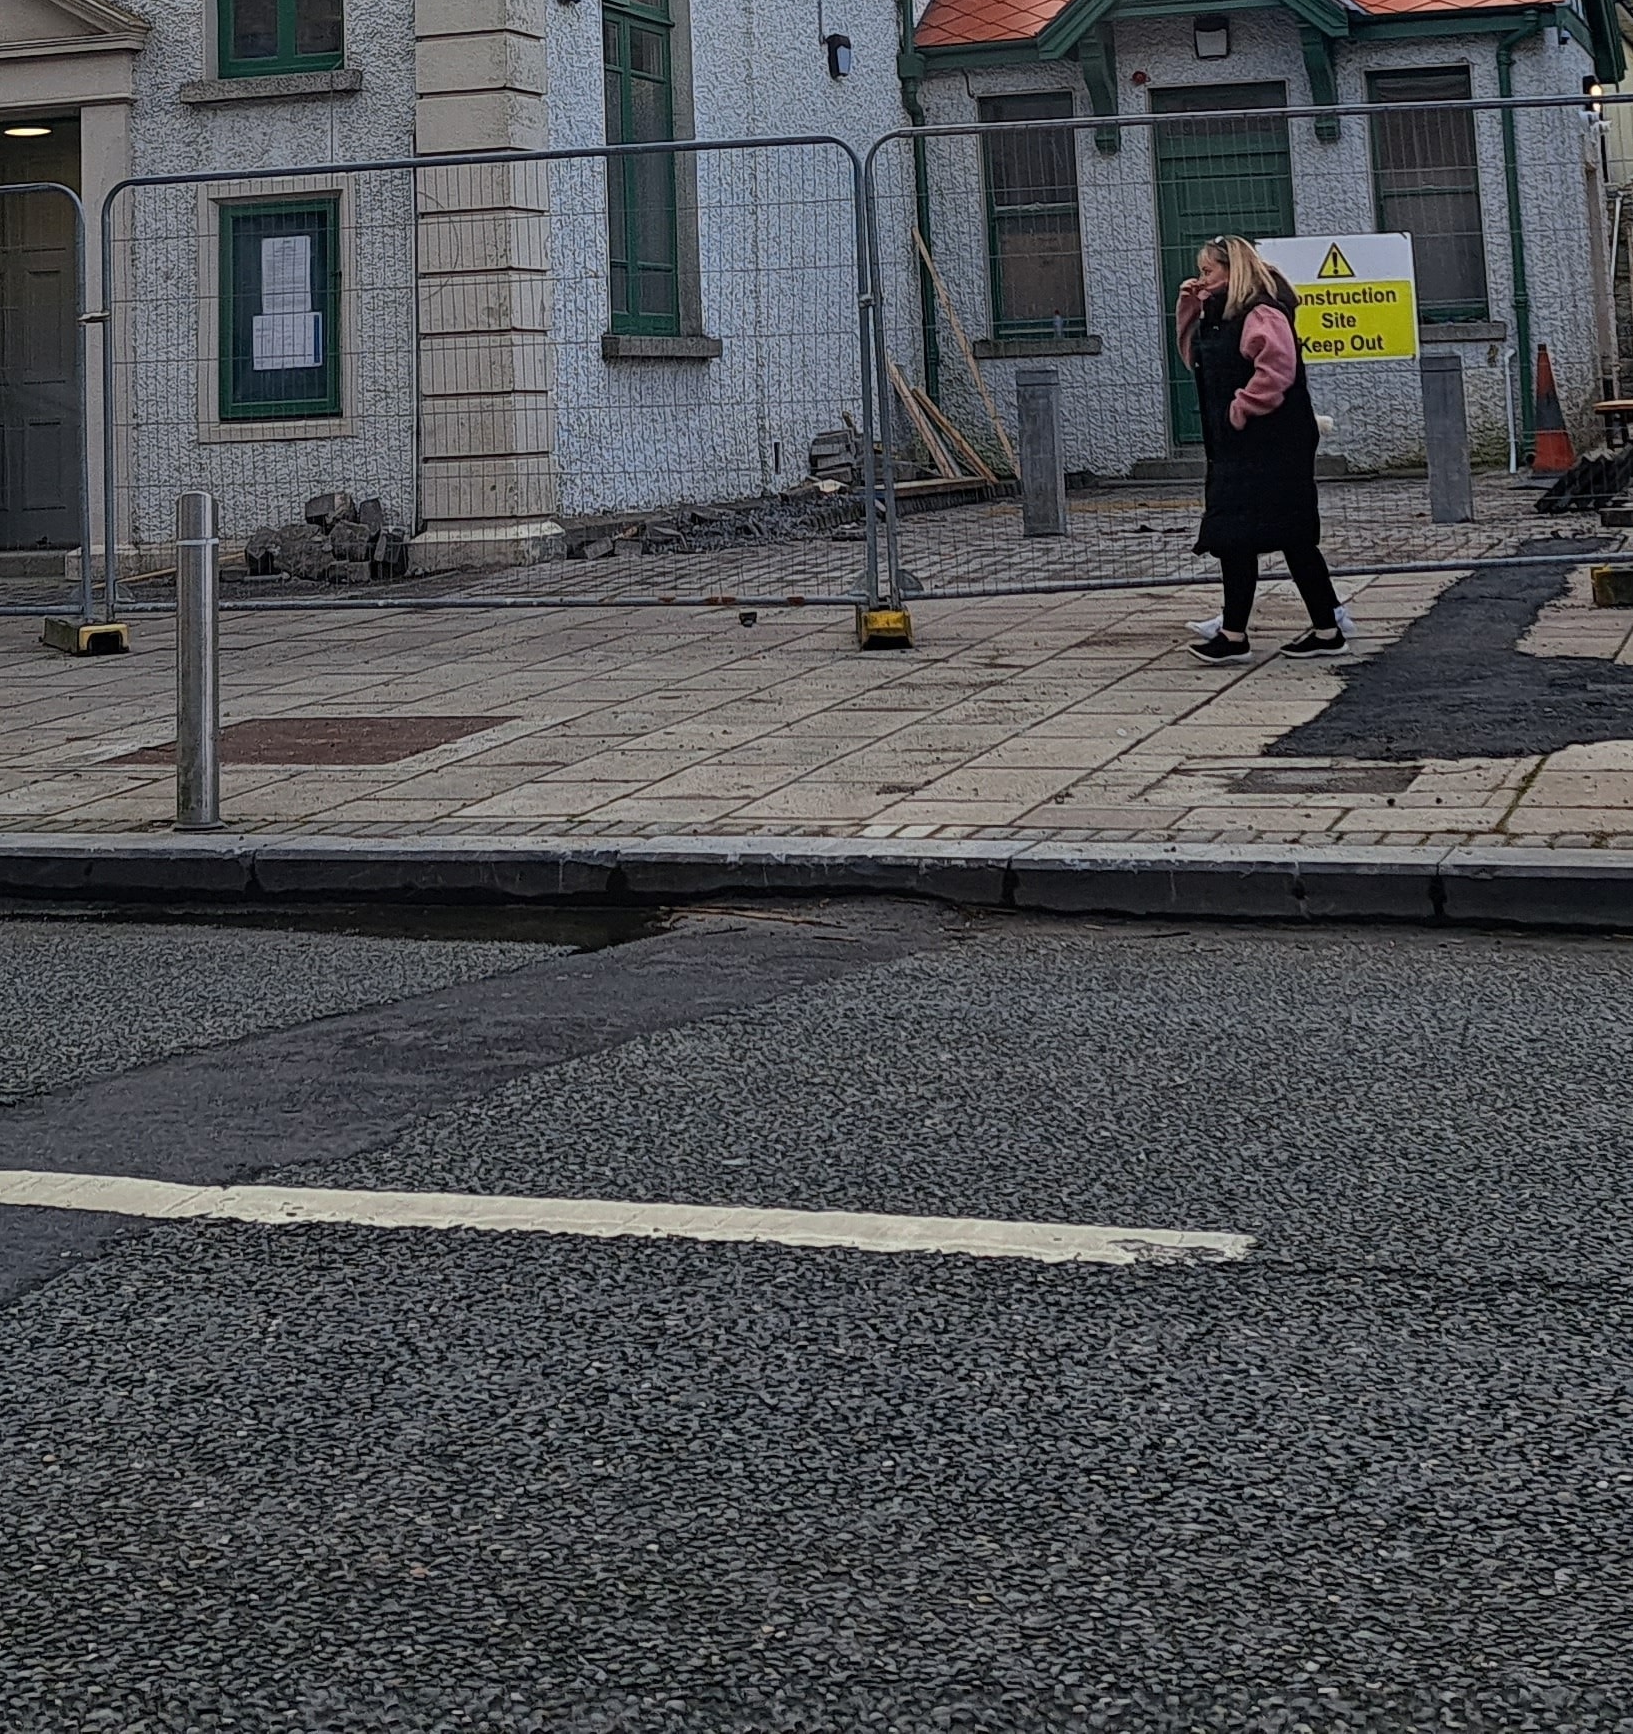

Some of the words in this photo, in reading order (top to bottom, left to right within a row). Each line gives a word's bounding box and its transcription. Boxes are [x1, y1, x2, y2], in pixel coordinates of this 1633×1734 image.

[1297, 287, 1397, 306] onstruction
[1321, 313, 1357, 329] Site
[1299, 335, 1345, 356] Keep
[1350, 334, 1385, 352] Out
